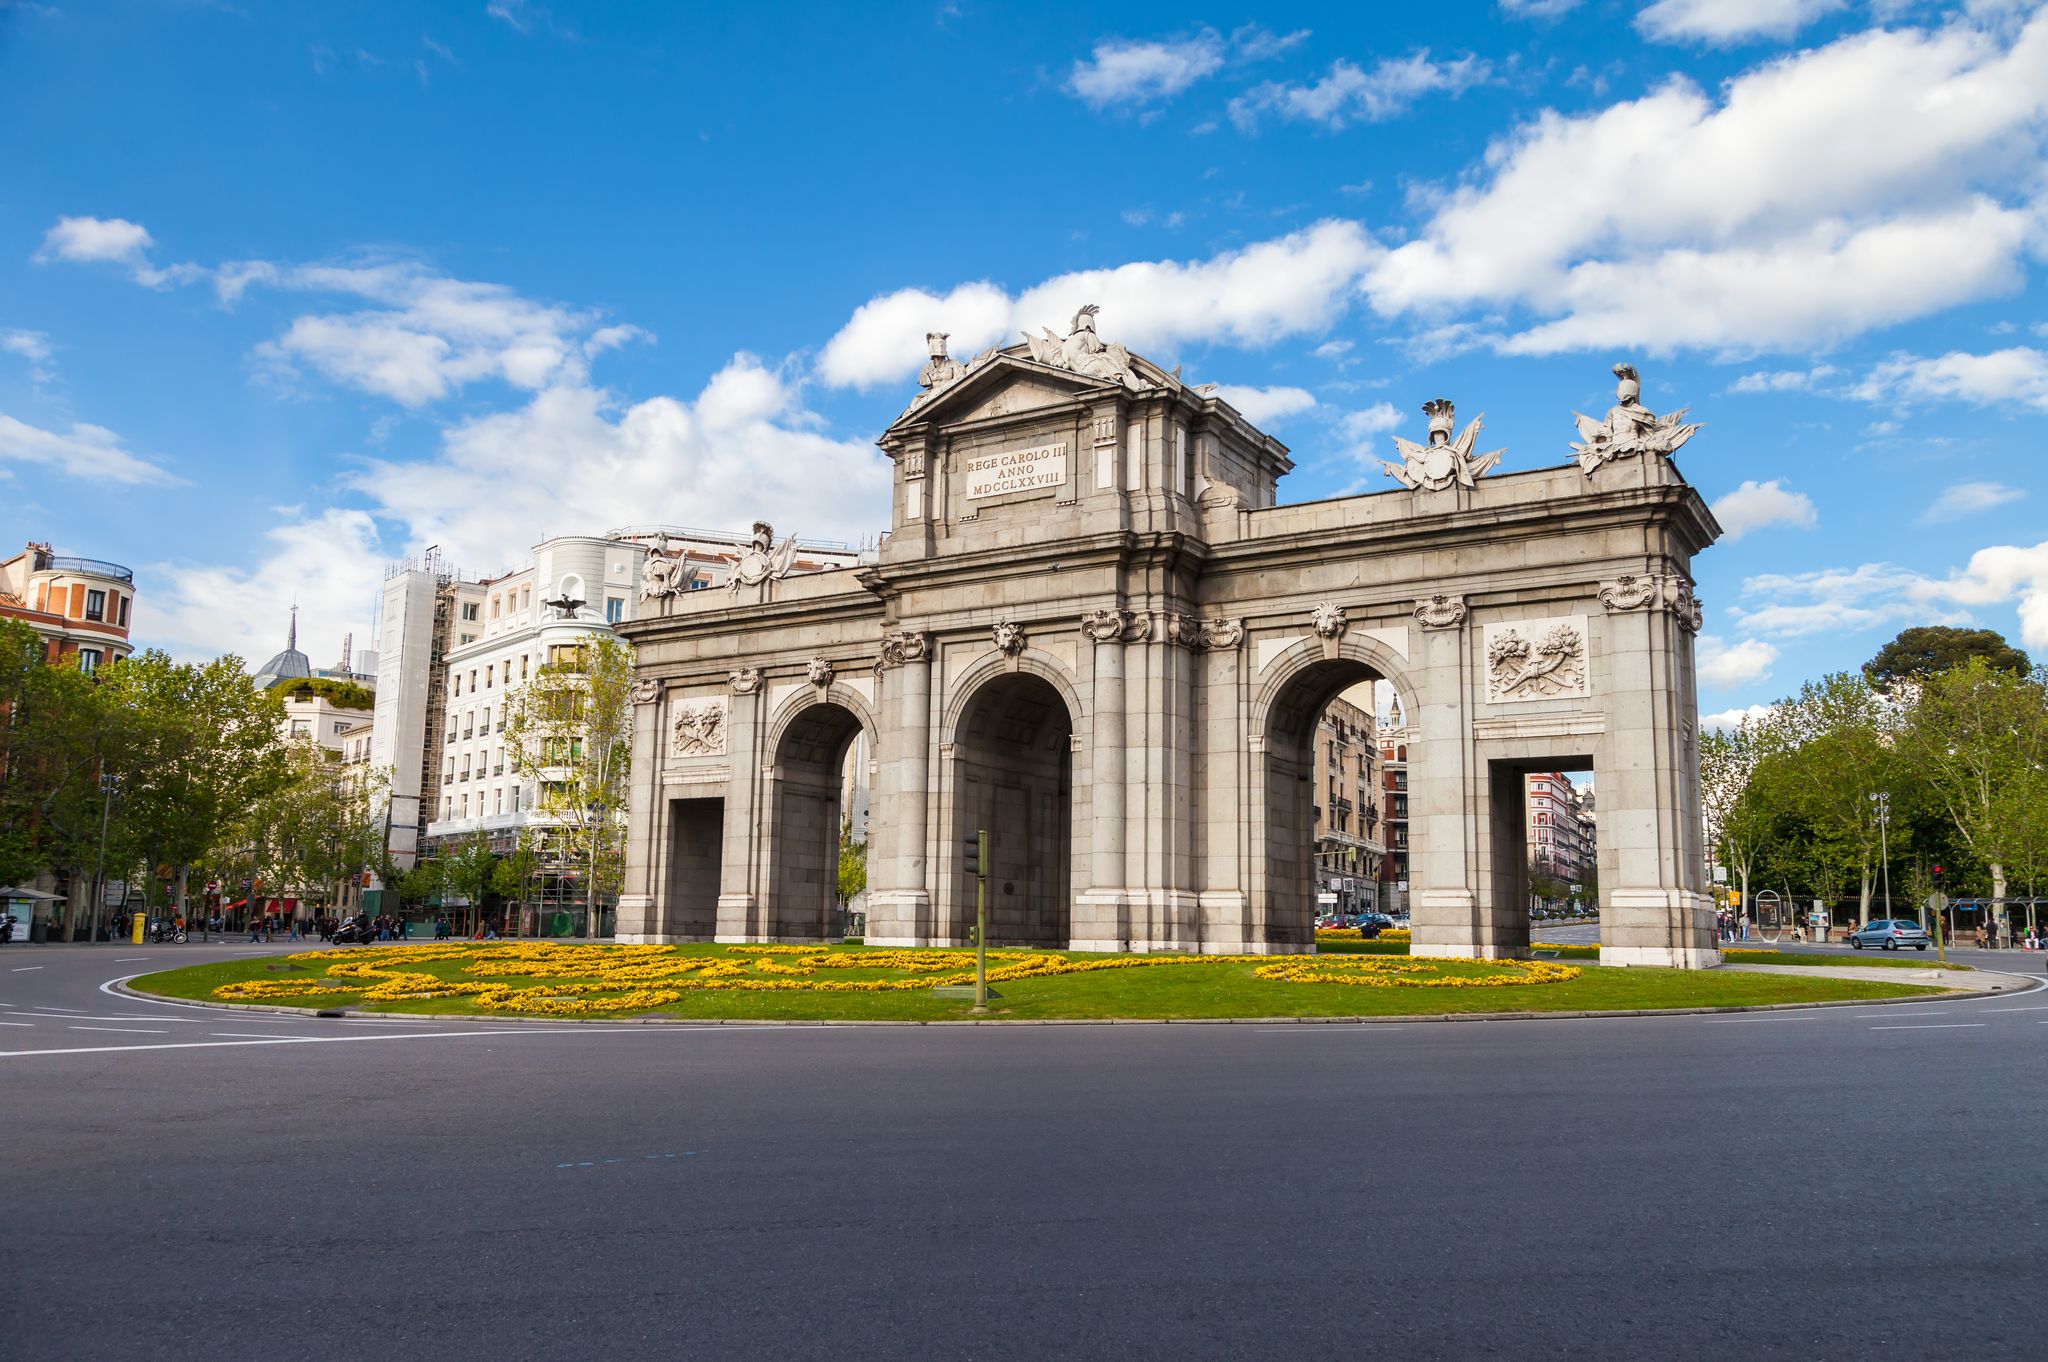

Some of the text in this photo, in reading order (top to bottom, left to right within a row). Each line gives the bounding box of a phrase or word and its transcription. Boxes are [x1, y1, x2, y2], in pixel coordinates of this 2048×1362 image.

[967, 446, 1067, 472] REGE CAROLO III
[998, 464, 1034, 479] ANNO
[973, 472, 1059, 495] MDCCLXXVIII
